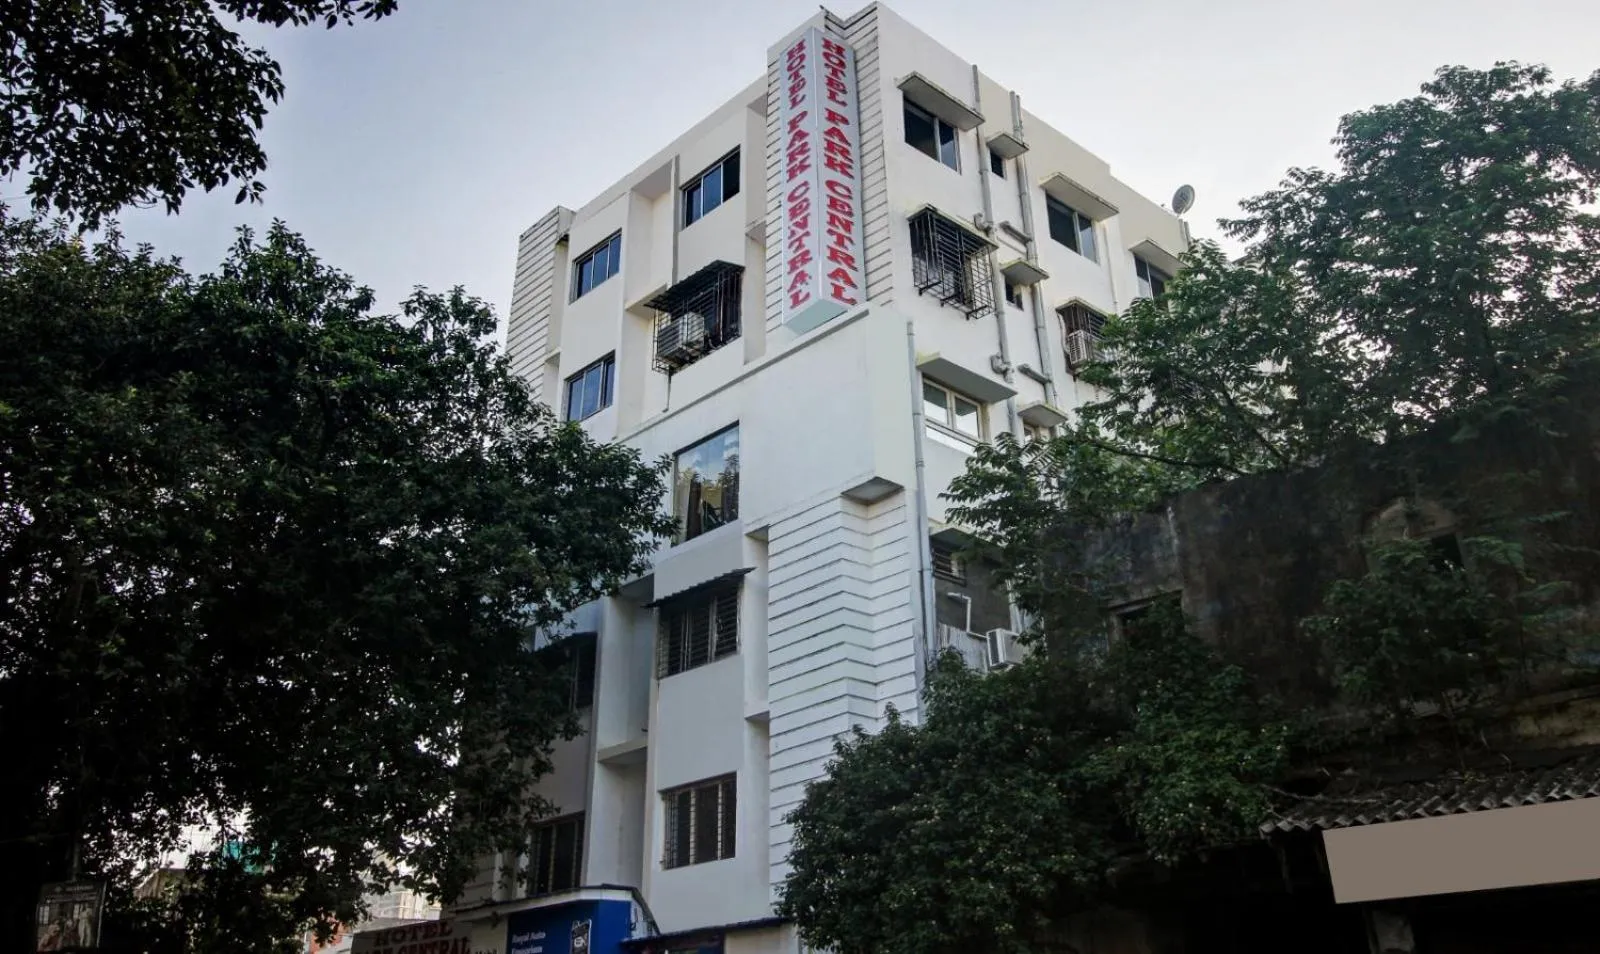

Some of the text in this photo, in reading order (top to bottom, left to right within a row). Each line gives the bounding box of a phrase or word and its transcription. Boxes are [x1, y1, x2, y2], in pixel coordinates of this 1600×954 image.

[786, 39, 812, 309] HOTEL PARK CENTRAL
[822, 37, 858, 306] HOTEL PARK CENTRAL
[373, 922, 453, 948] HOTEL
